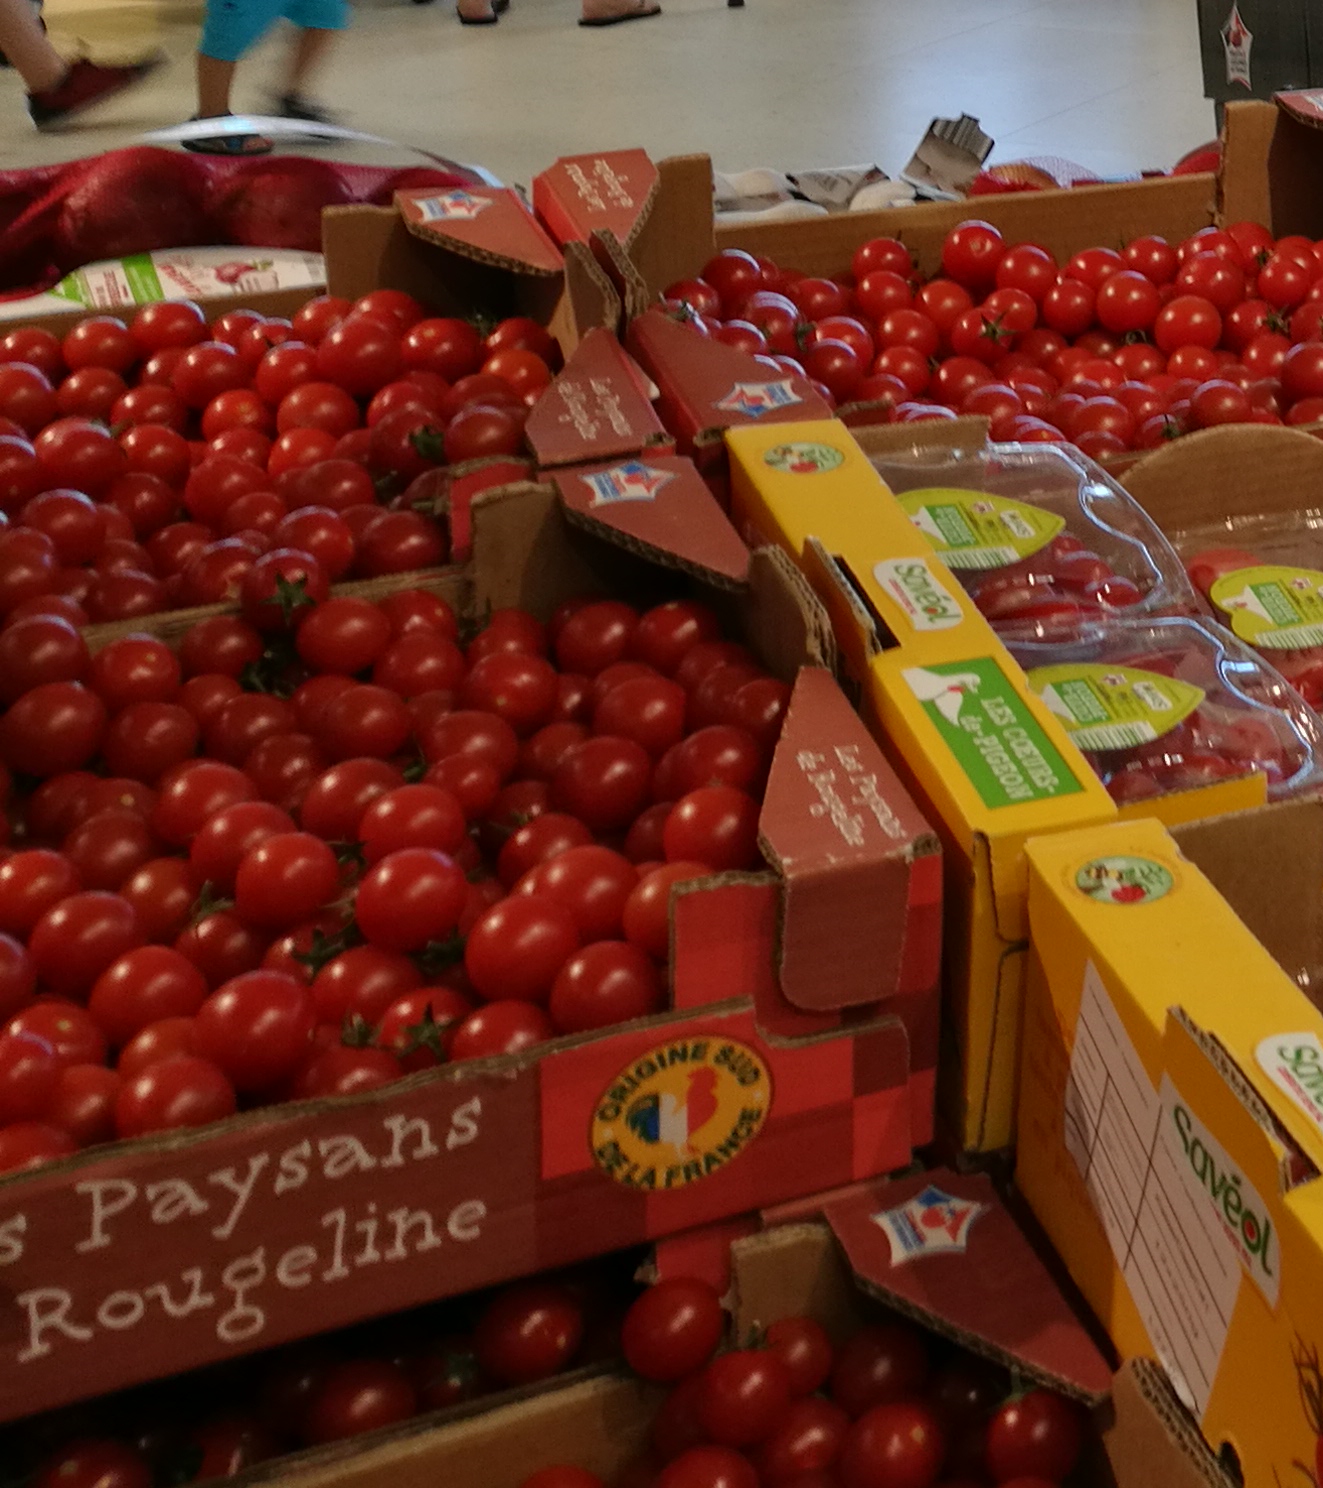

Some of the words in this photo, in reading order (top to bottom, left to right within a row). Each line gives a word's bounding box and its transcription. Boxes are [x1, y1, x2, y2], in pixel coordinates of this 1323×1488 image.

[894, 563, 961, 627] Savéol
[981, 695, 1017, 726] LES
[598, 1042, 709, 1121] ORIGINE
[714, 1045, 760, 1087] SUD
[76, 1095, 484, 1254] Paysans
[665, 1107, 762, 1188] FRANCE
[1173, 1104, 1275, 1278] Savéol
[17, 1198, 487, 1364] Rougeline
